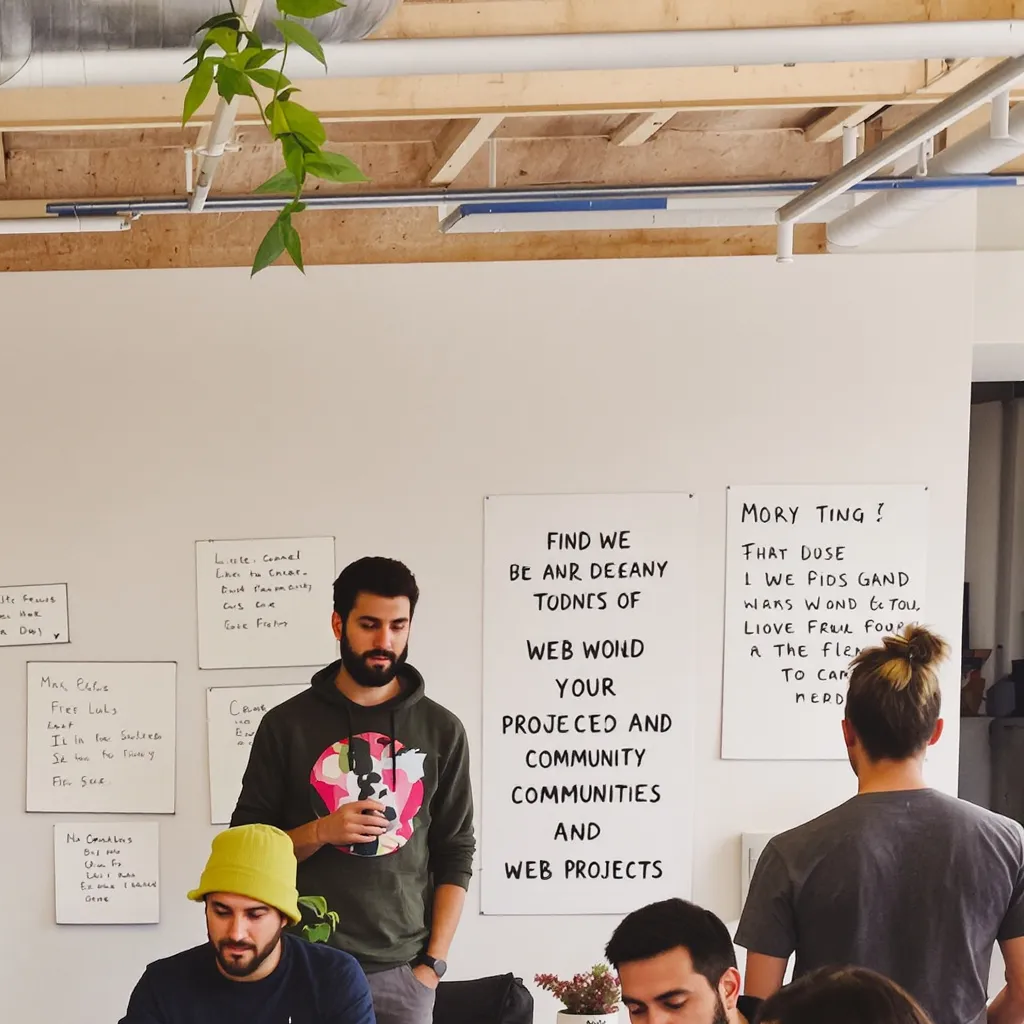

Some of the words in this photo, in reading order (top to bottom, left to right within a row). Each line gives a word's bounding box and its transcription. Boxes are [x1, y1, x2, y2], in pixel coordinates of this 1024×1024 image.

[741, 502, 799, 525] MORY
[815, 504, 865, 524] TING
[547, 530, 592, 551] FIND
[599, 530, 631, 550] WE
[509, 563, 532, 582] BE
[542, 562, 583, 582] ANR
[764, 572, 795, 587] WE
[857, 571, 910, 588] GAND
[617, 590, 642, 610] OF
[526, 639, 574, 661] WEB
[555, 677, 617, 699] YOUR
[502, 714, 617, 735] PROJECED
[628, 713, 672, 733] AND
[525, 747, 646, 769] COMMUNITY
[511, 783, 661, 805] COMMUNITIES
[553, 821, 601, 842] AND
[504, 859, 553, 881] WEB
[564, 859, 663, 880] PROJECTS
